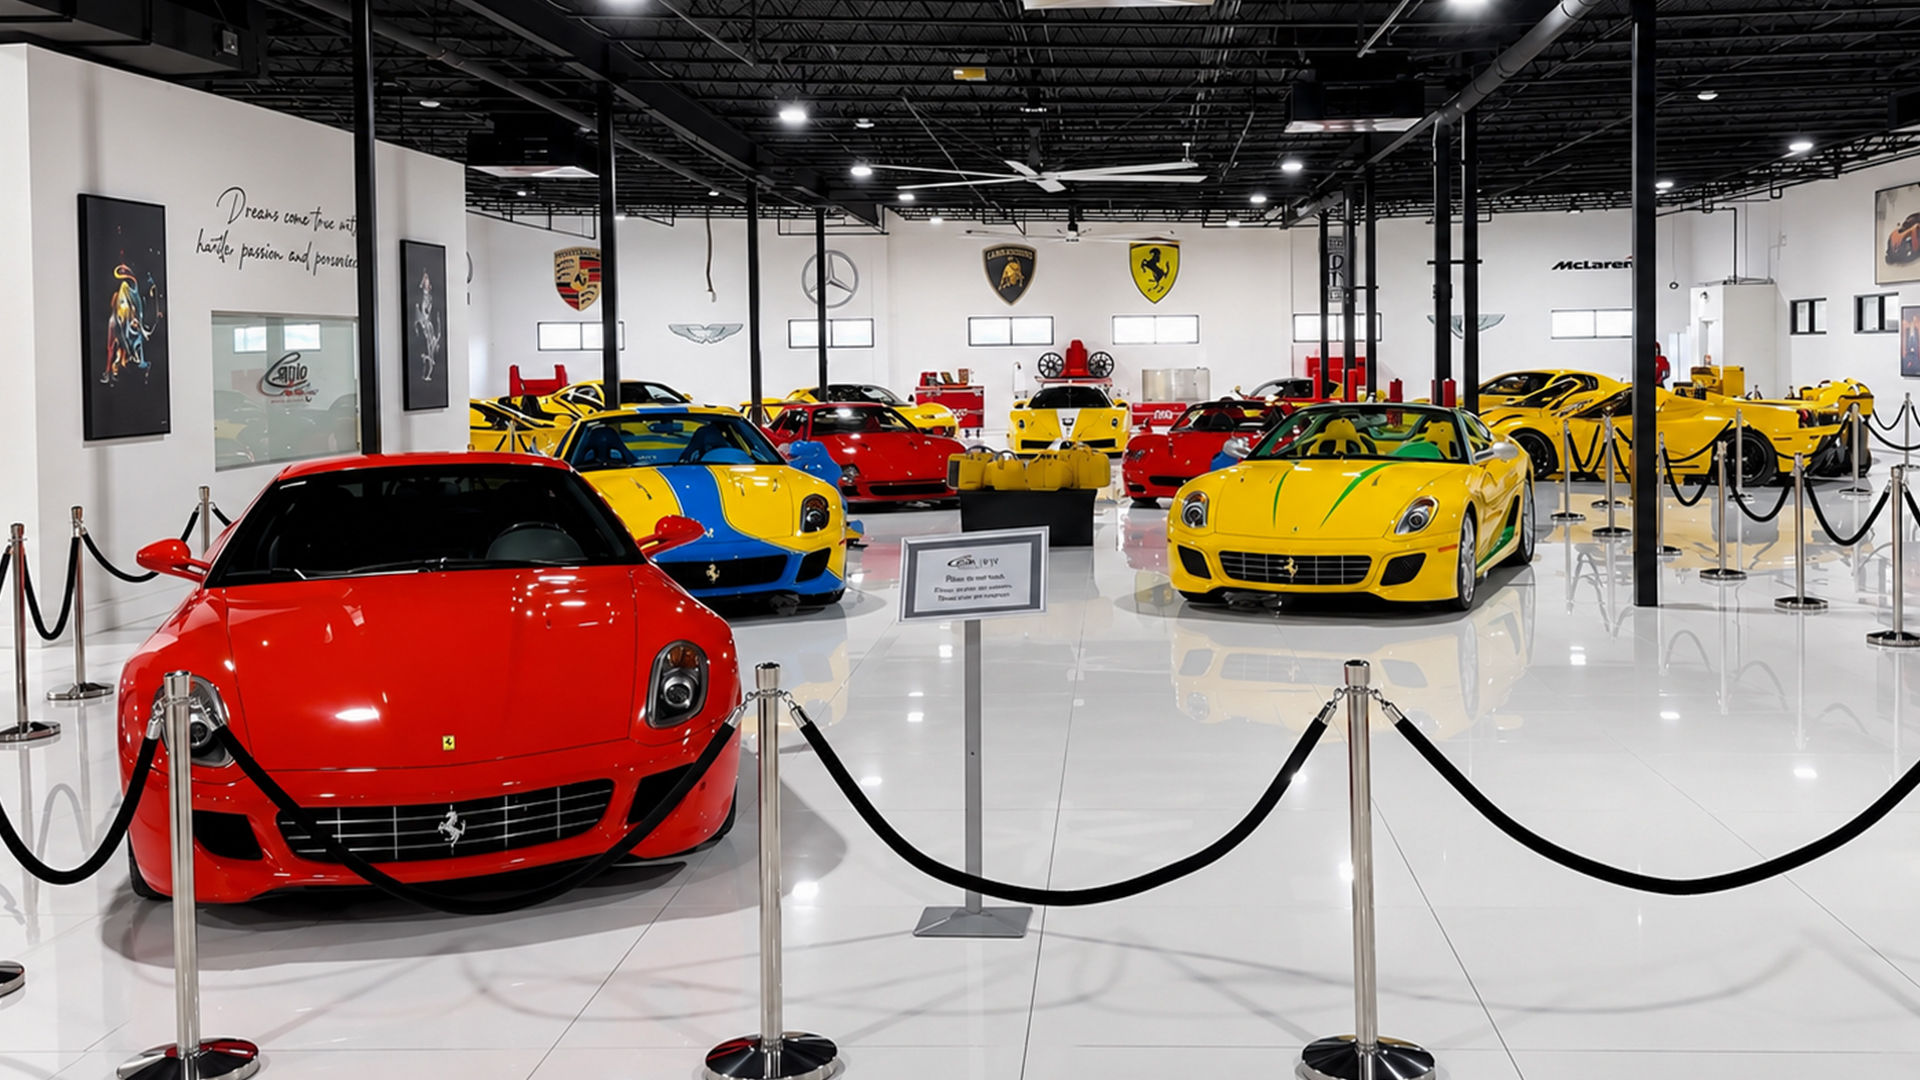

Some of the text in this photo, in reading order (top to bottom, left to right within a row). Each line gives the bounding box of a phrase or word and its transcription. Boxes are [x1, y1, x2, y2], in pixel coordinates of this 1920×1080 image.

[216, 186, 279, 225] Dreams
[284, 212, 310, 226] come
[239, 243, 284, 270] passion
[288, 241, 312, 271] and
[1551, 260, 1633, 270] McLaren
